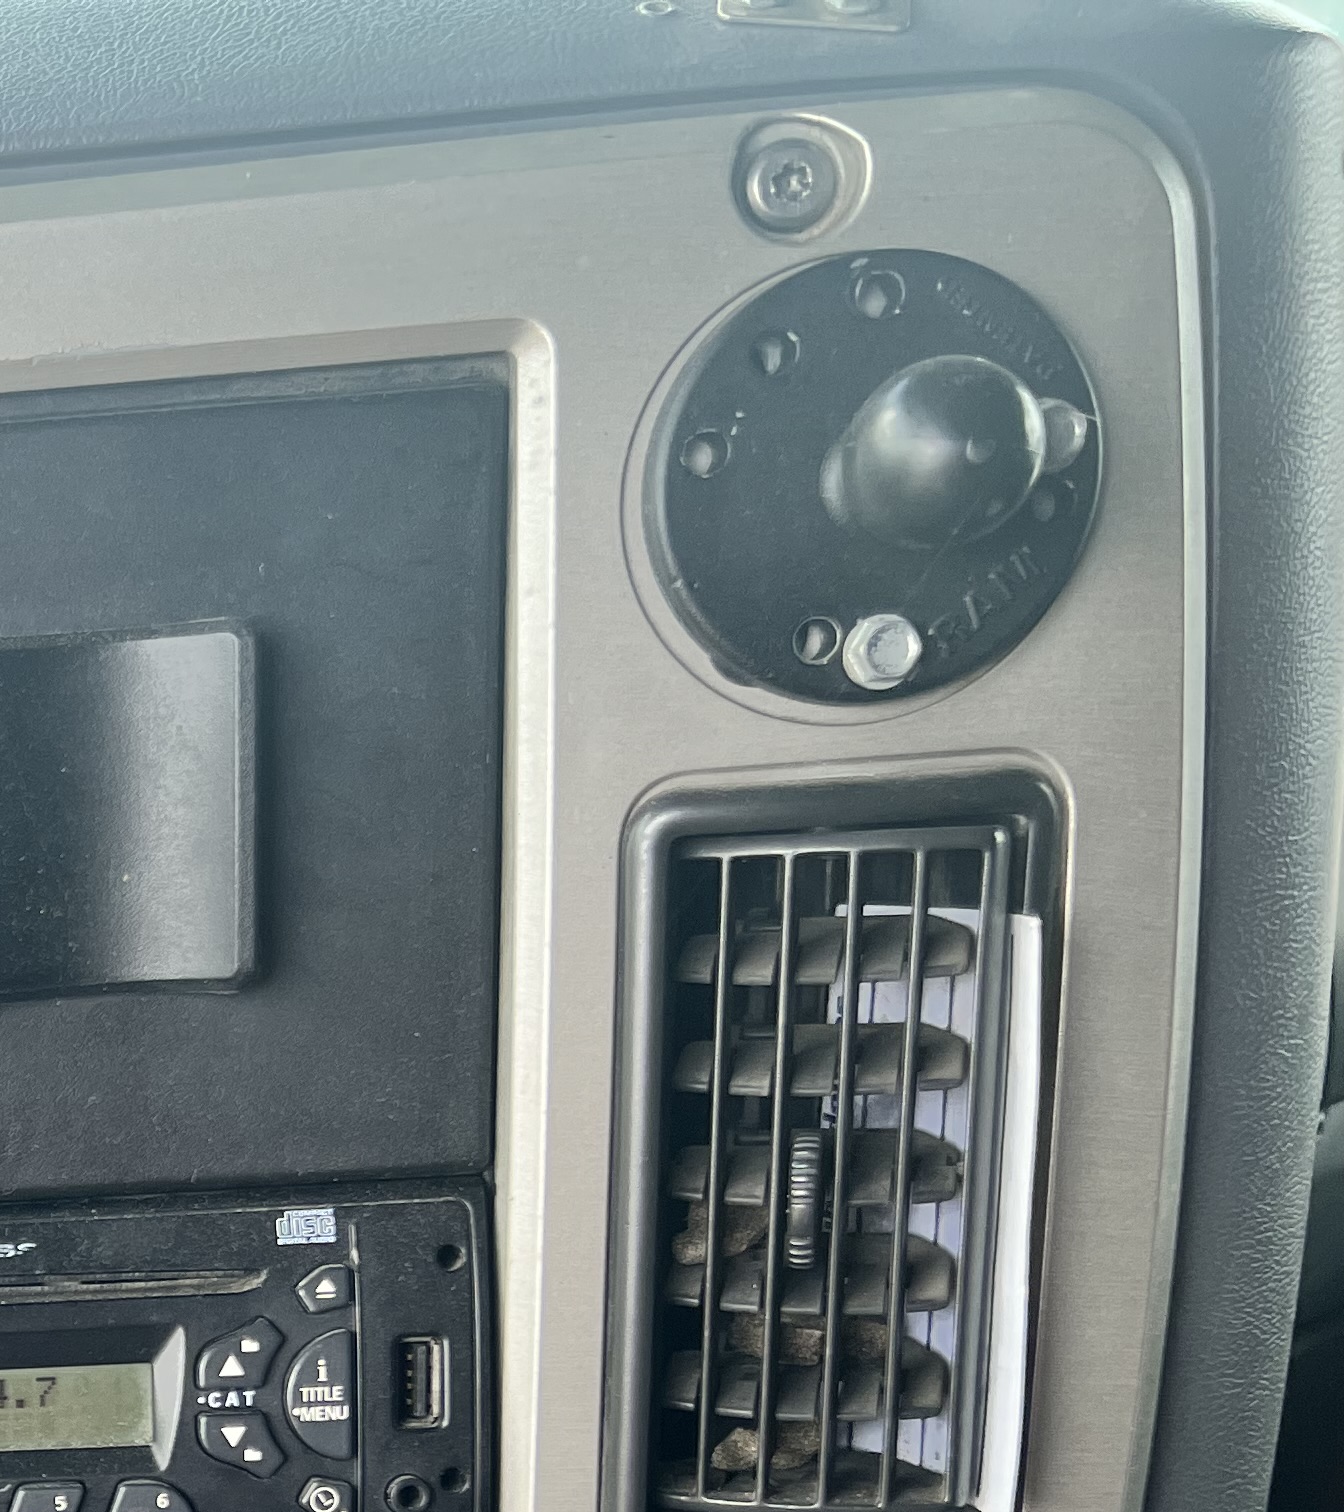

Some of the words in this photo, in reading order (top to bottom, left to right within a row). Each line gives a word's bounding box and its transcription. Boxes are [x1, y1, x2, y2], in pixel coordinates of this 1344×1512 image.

[299, 1385, 344, 1402] TITLE
[54, 1495, 68, 1511] 5
[156, 1493, 170, 1509] 6
